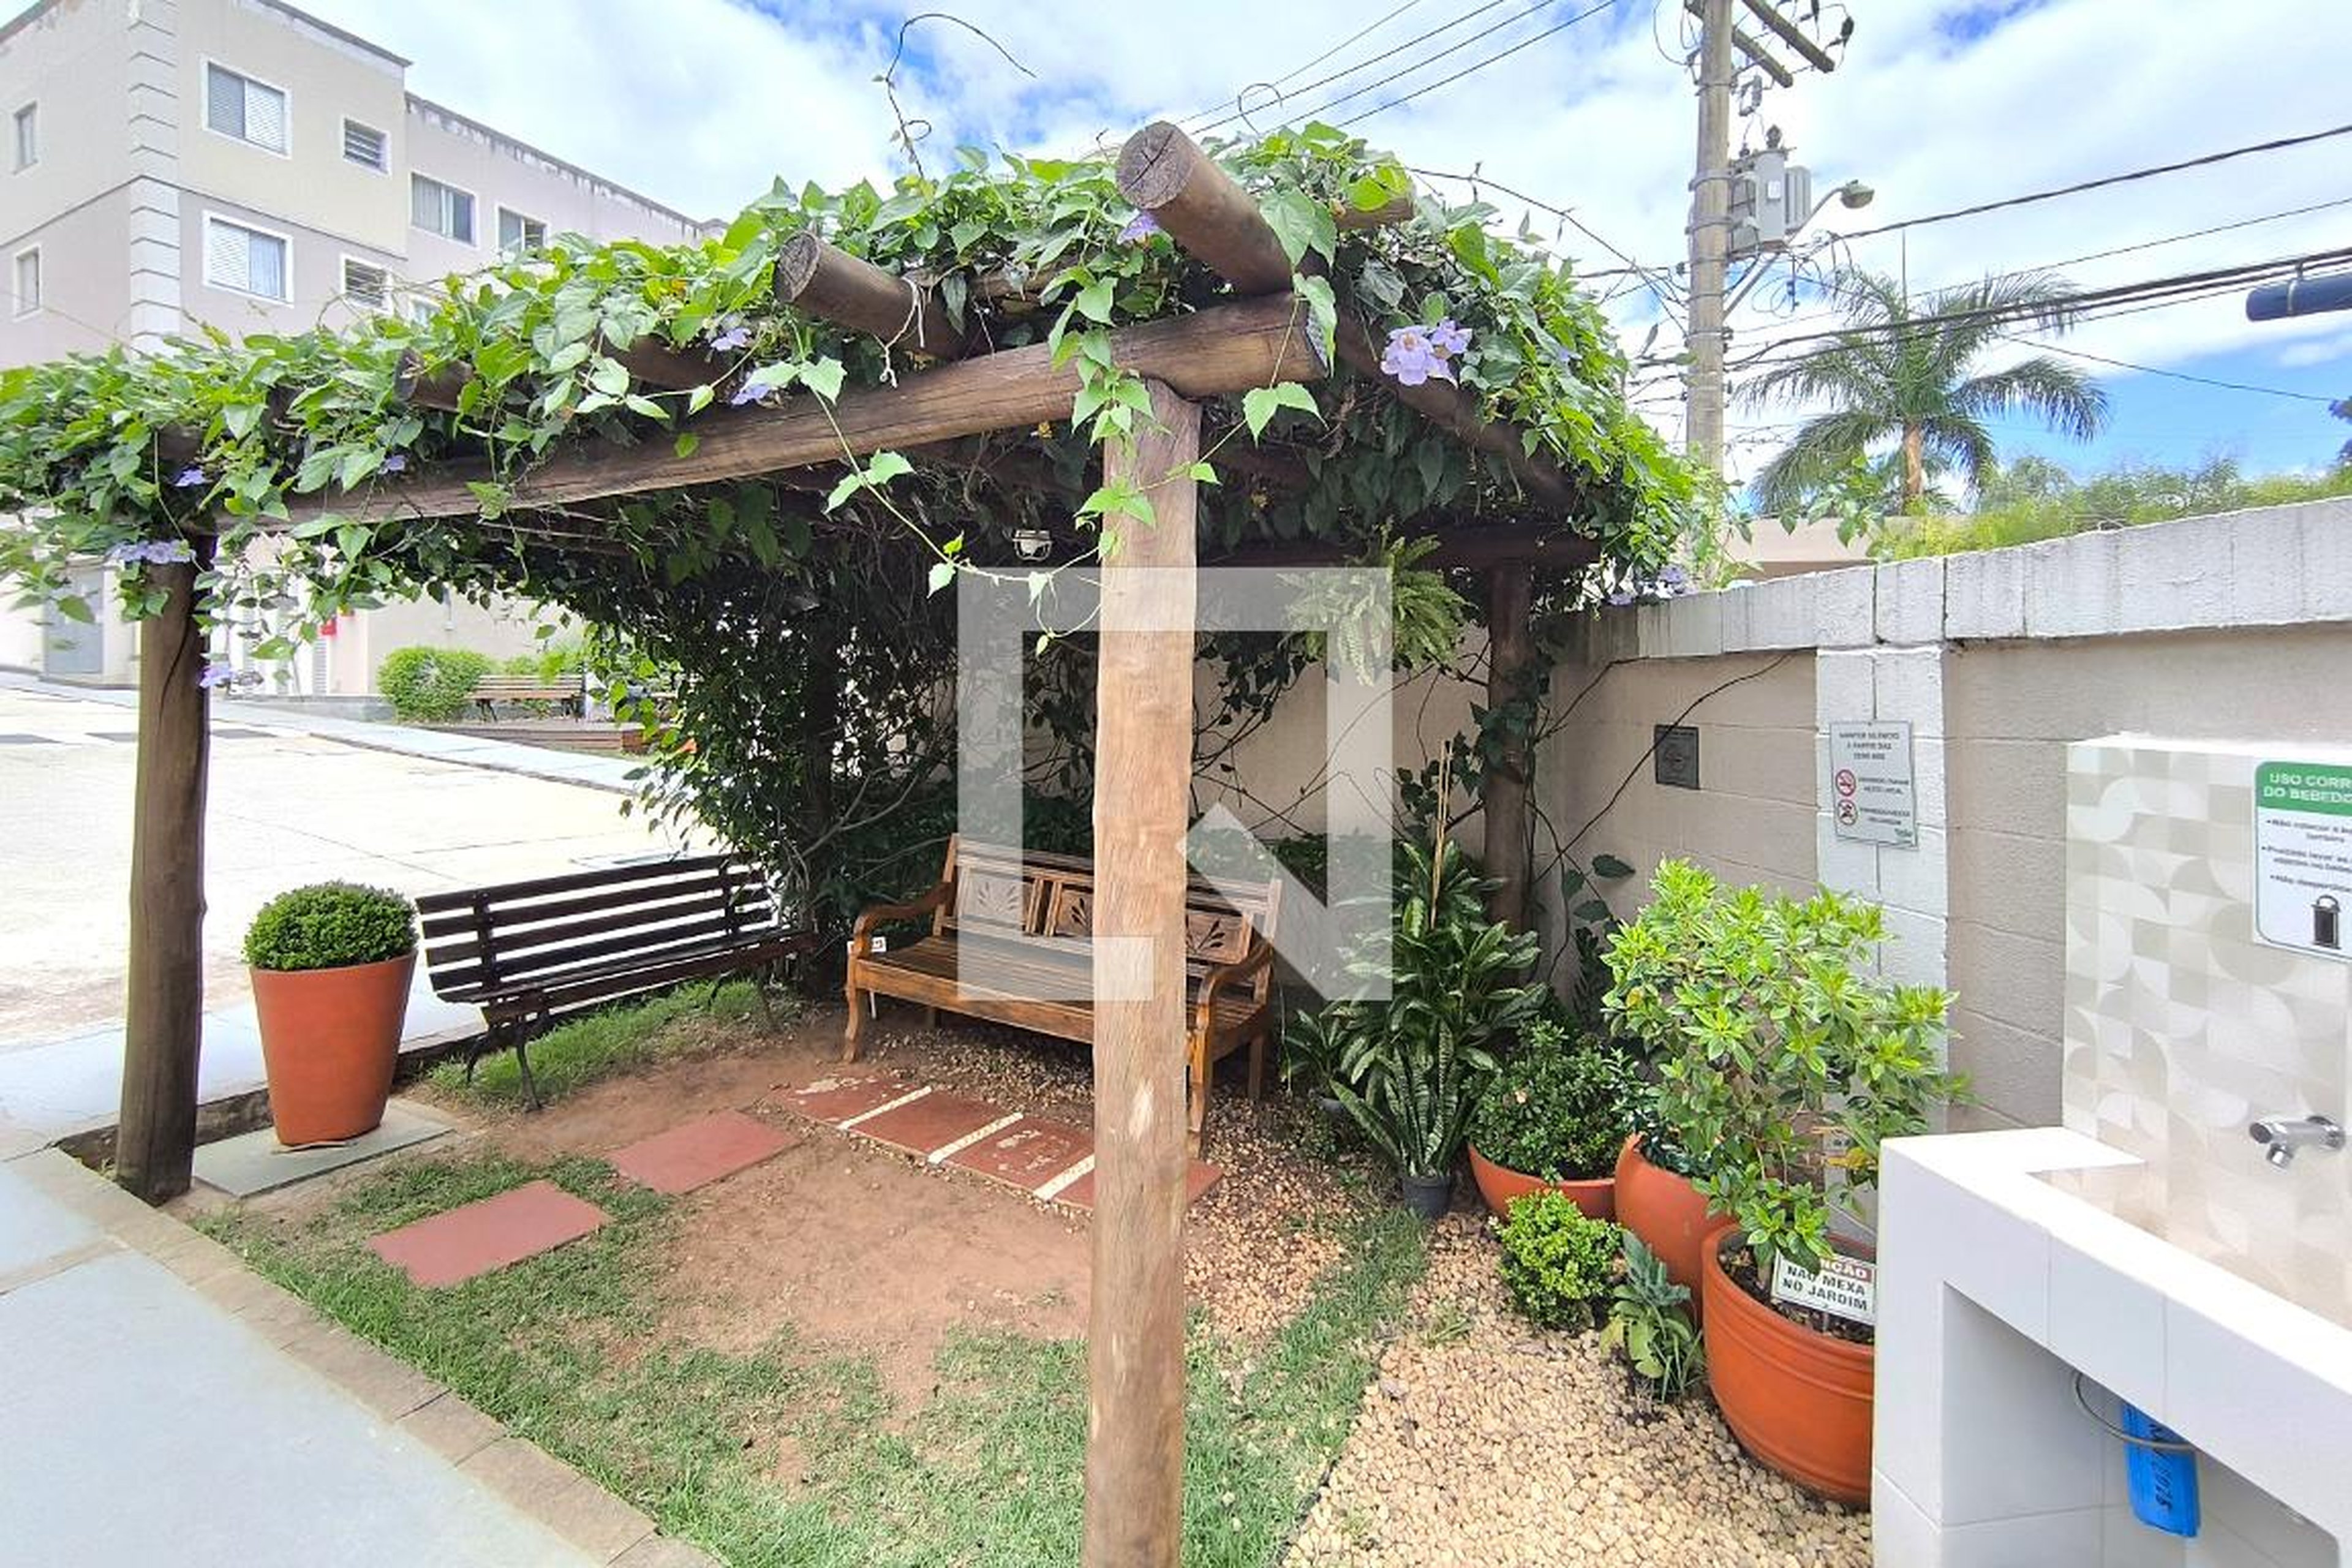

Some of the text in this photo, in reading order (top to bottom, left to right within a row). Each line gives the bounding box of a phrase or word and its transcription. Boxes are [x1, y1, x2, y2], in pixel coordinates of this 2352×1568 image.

[2269, 772, 2302, 785] USO
[2264, 785, 2286, 797] DO
[1822, 1275, 1865, 1295] MEXA
[1783, 1278, 1867, 1311] NO JARDIM
